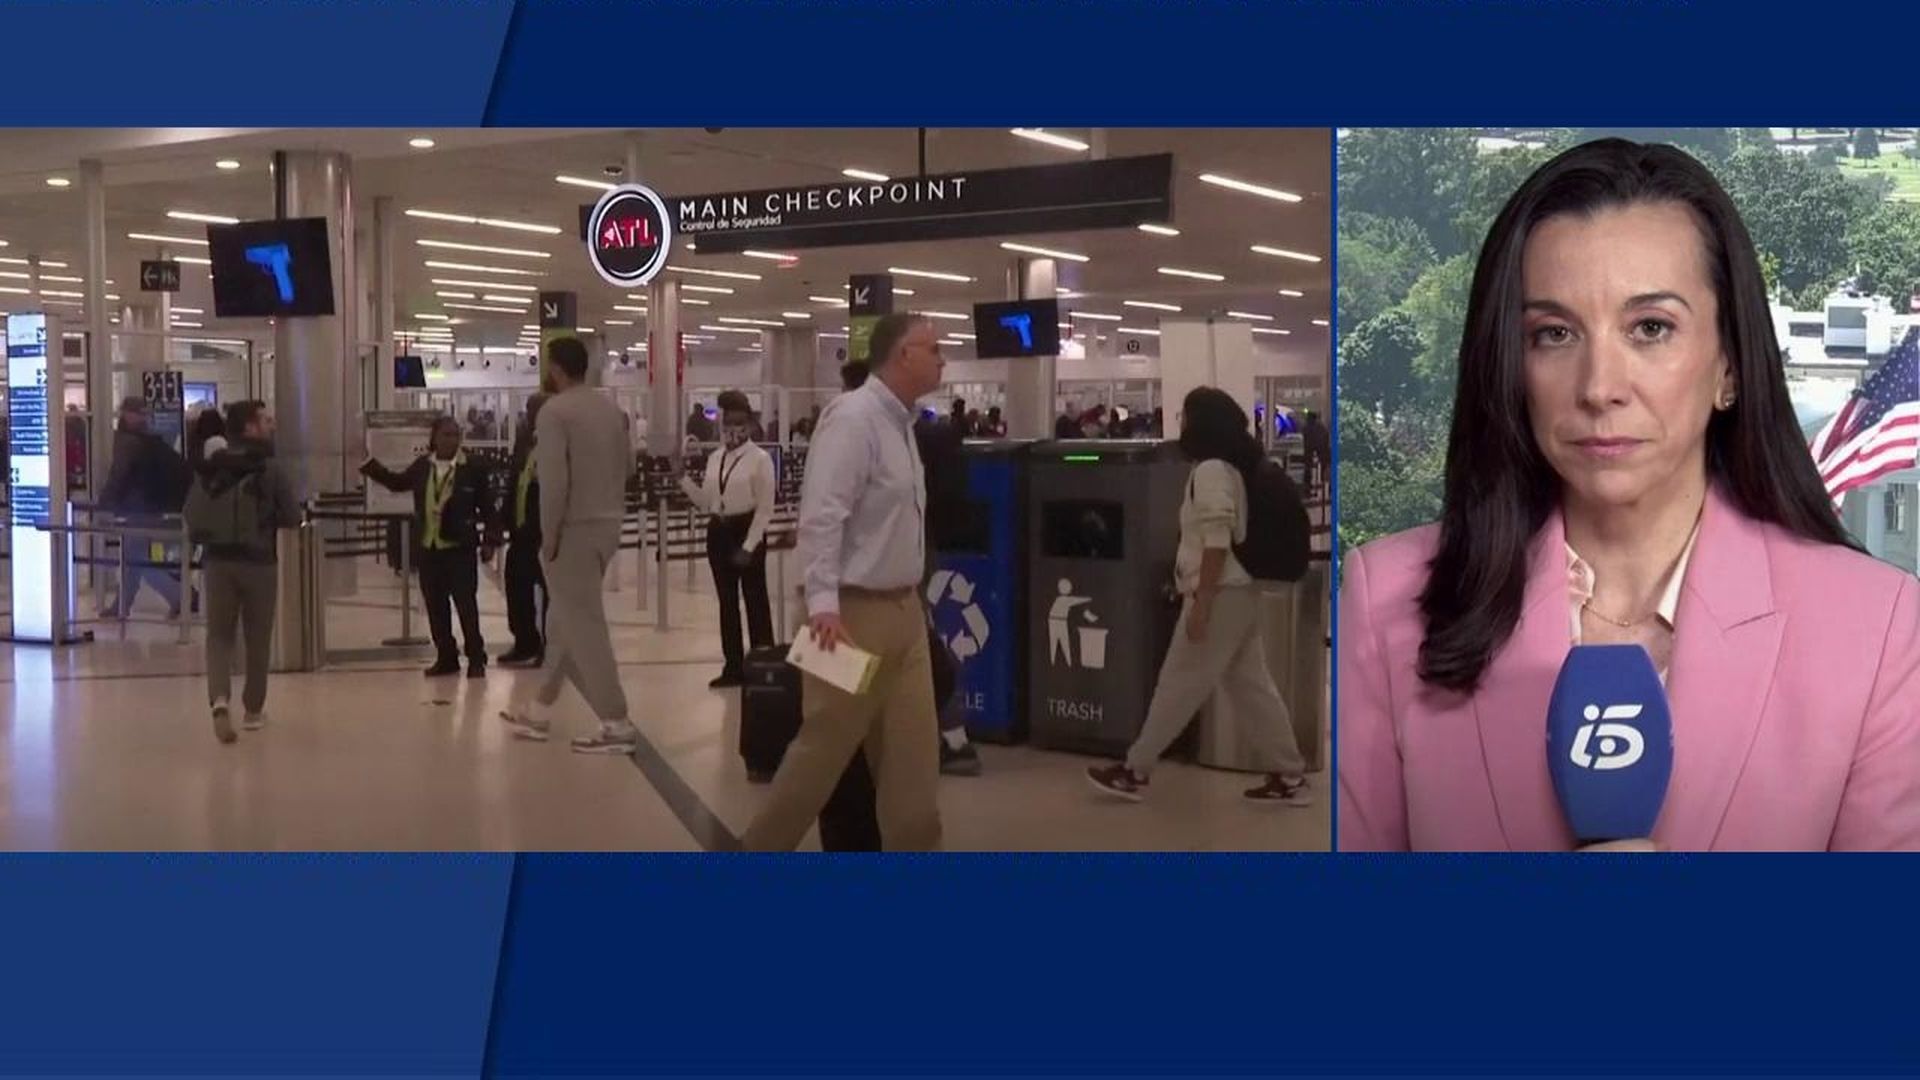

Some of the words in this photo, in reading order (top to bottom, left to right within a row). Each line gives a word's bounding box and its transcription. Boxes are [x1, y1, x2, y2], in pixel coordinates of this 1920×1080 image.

[680, 196, 748, 220] MAIN
[766, 177, 967, 213] CHECKPOINT
[602, 218, 658, 249] ATL
[680, 219, 715, 232] Control
[717, 216, 730, 229] de
[732, 214, 782, 230] Seguridad
[1047, 699, 1104, 721] TRASH
